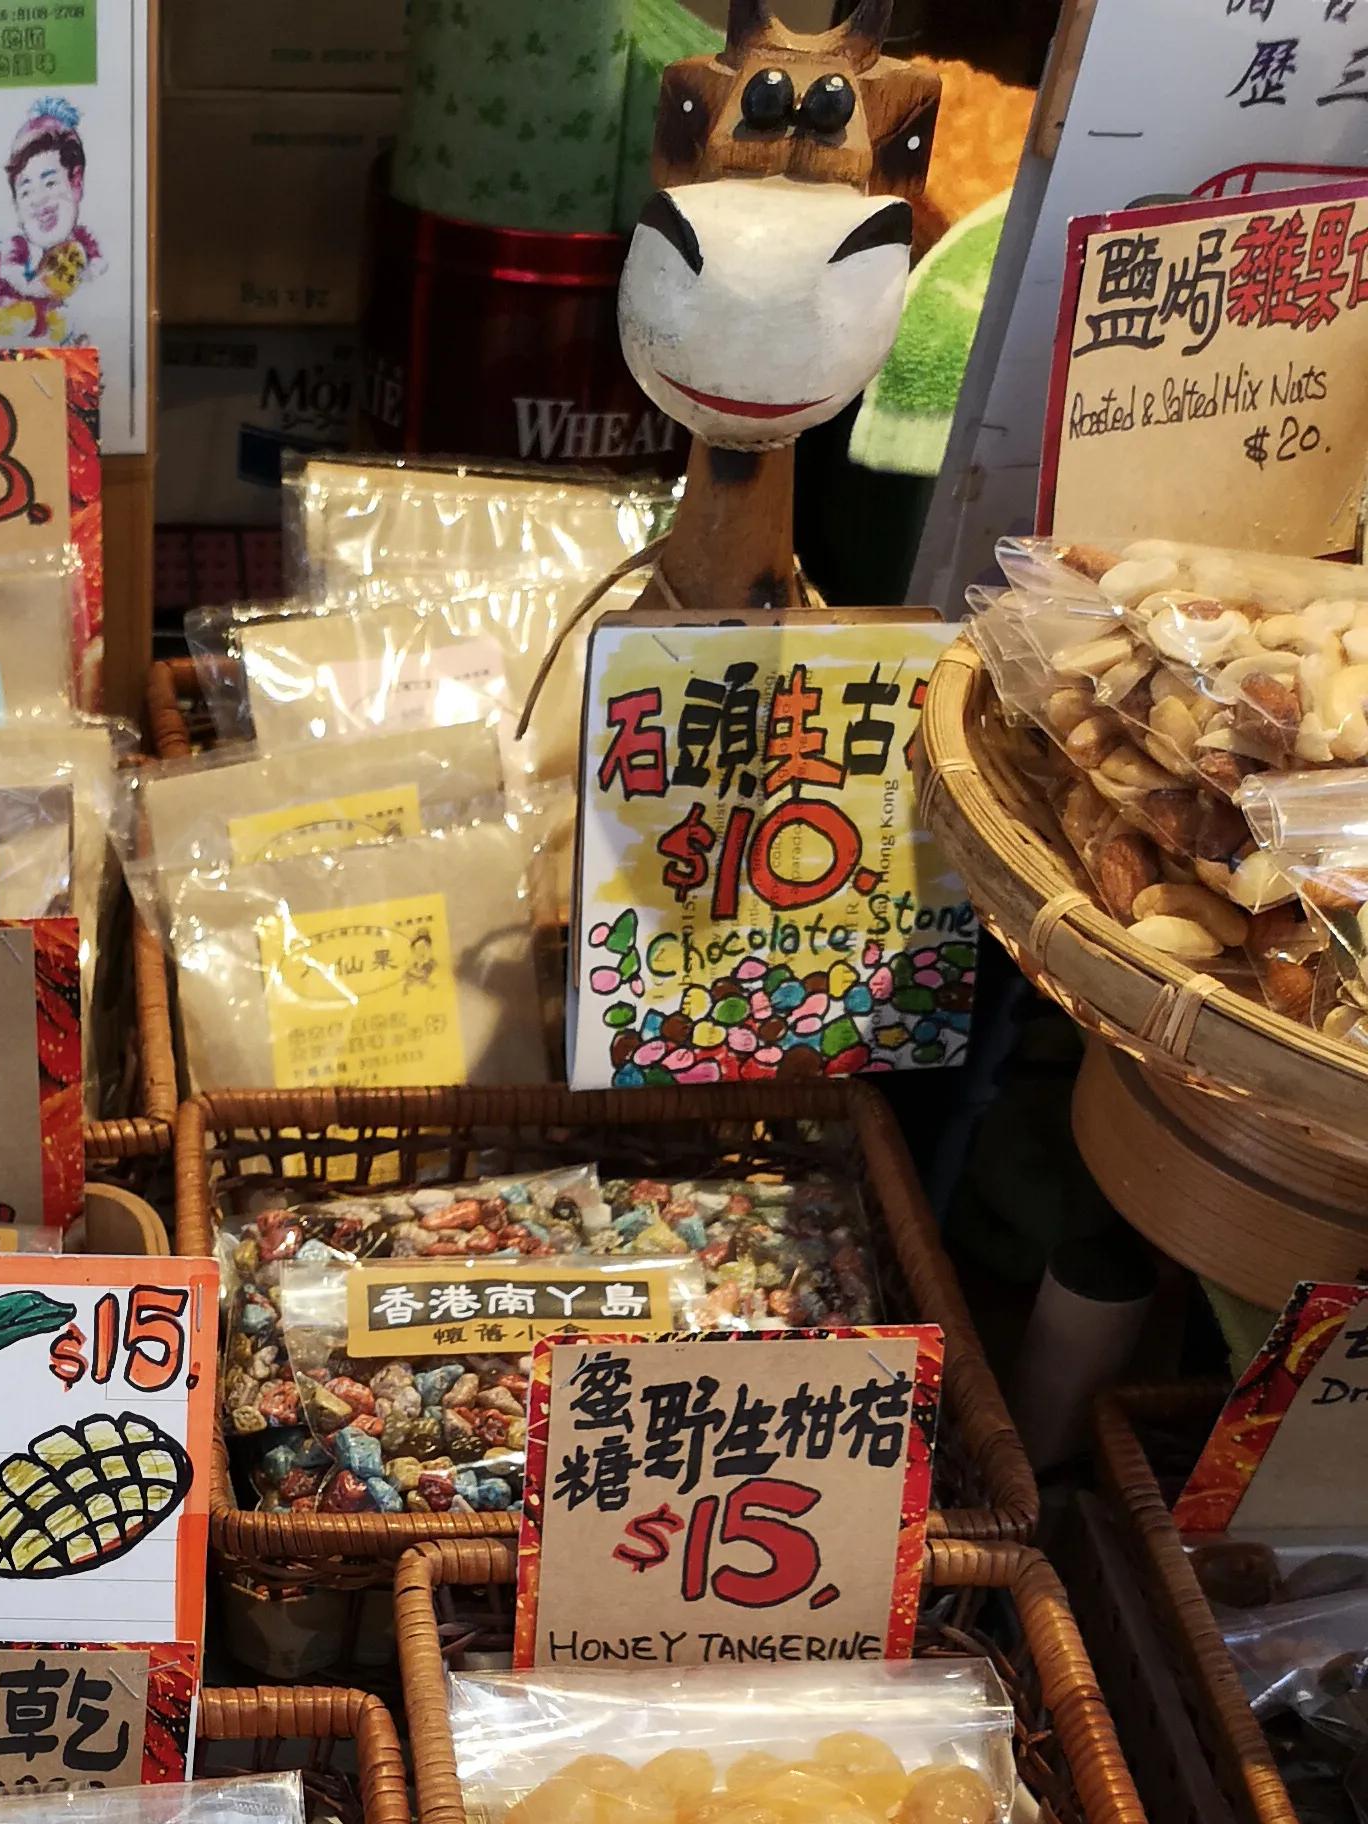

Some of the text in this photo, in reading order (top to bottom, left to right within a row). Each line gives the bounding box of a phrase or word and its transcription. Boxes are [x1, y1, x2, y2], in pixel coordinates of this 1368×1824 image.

[1069, 385, 1136, 440] Roasted
[1141, 392, 1154, 427] &
[1221, 362, 1264, 415] Mix
[1269, 361, 1328, 407] Nuts
[657, 795, 882, 920] $10.
[301, 949, 399, 980] 仙果
[645, 912, 854, 978] Chocolate
[372, 1282, 648, 1326] 香港南丫島
[1312, 1377, 1368, 1405] Dr
[548, 1630, 884, 1664] HONEY TANGERINE
